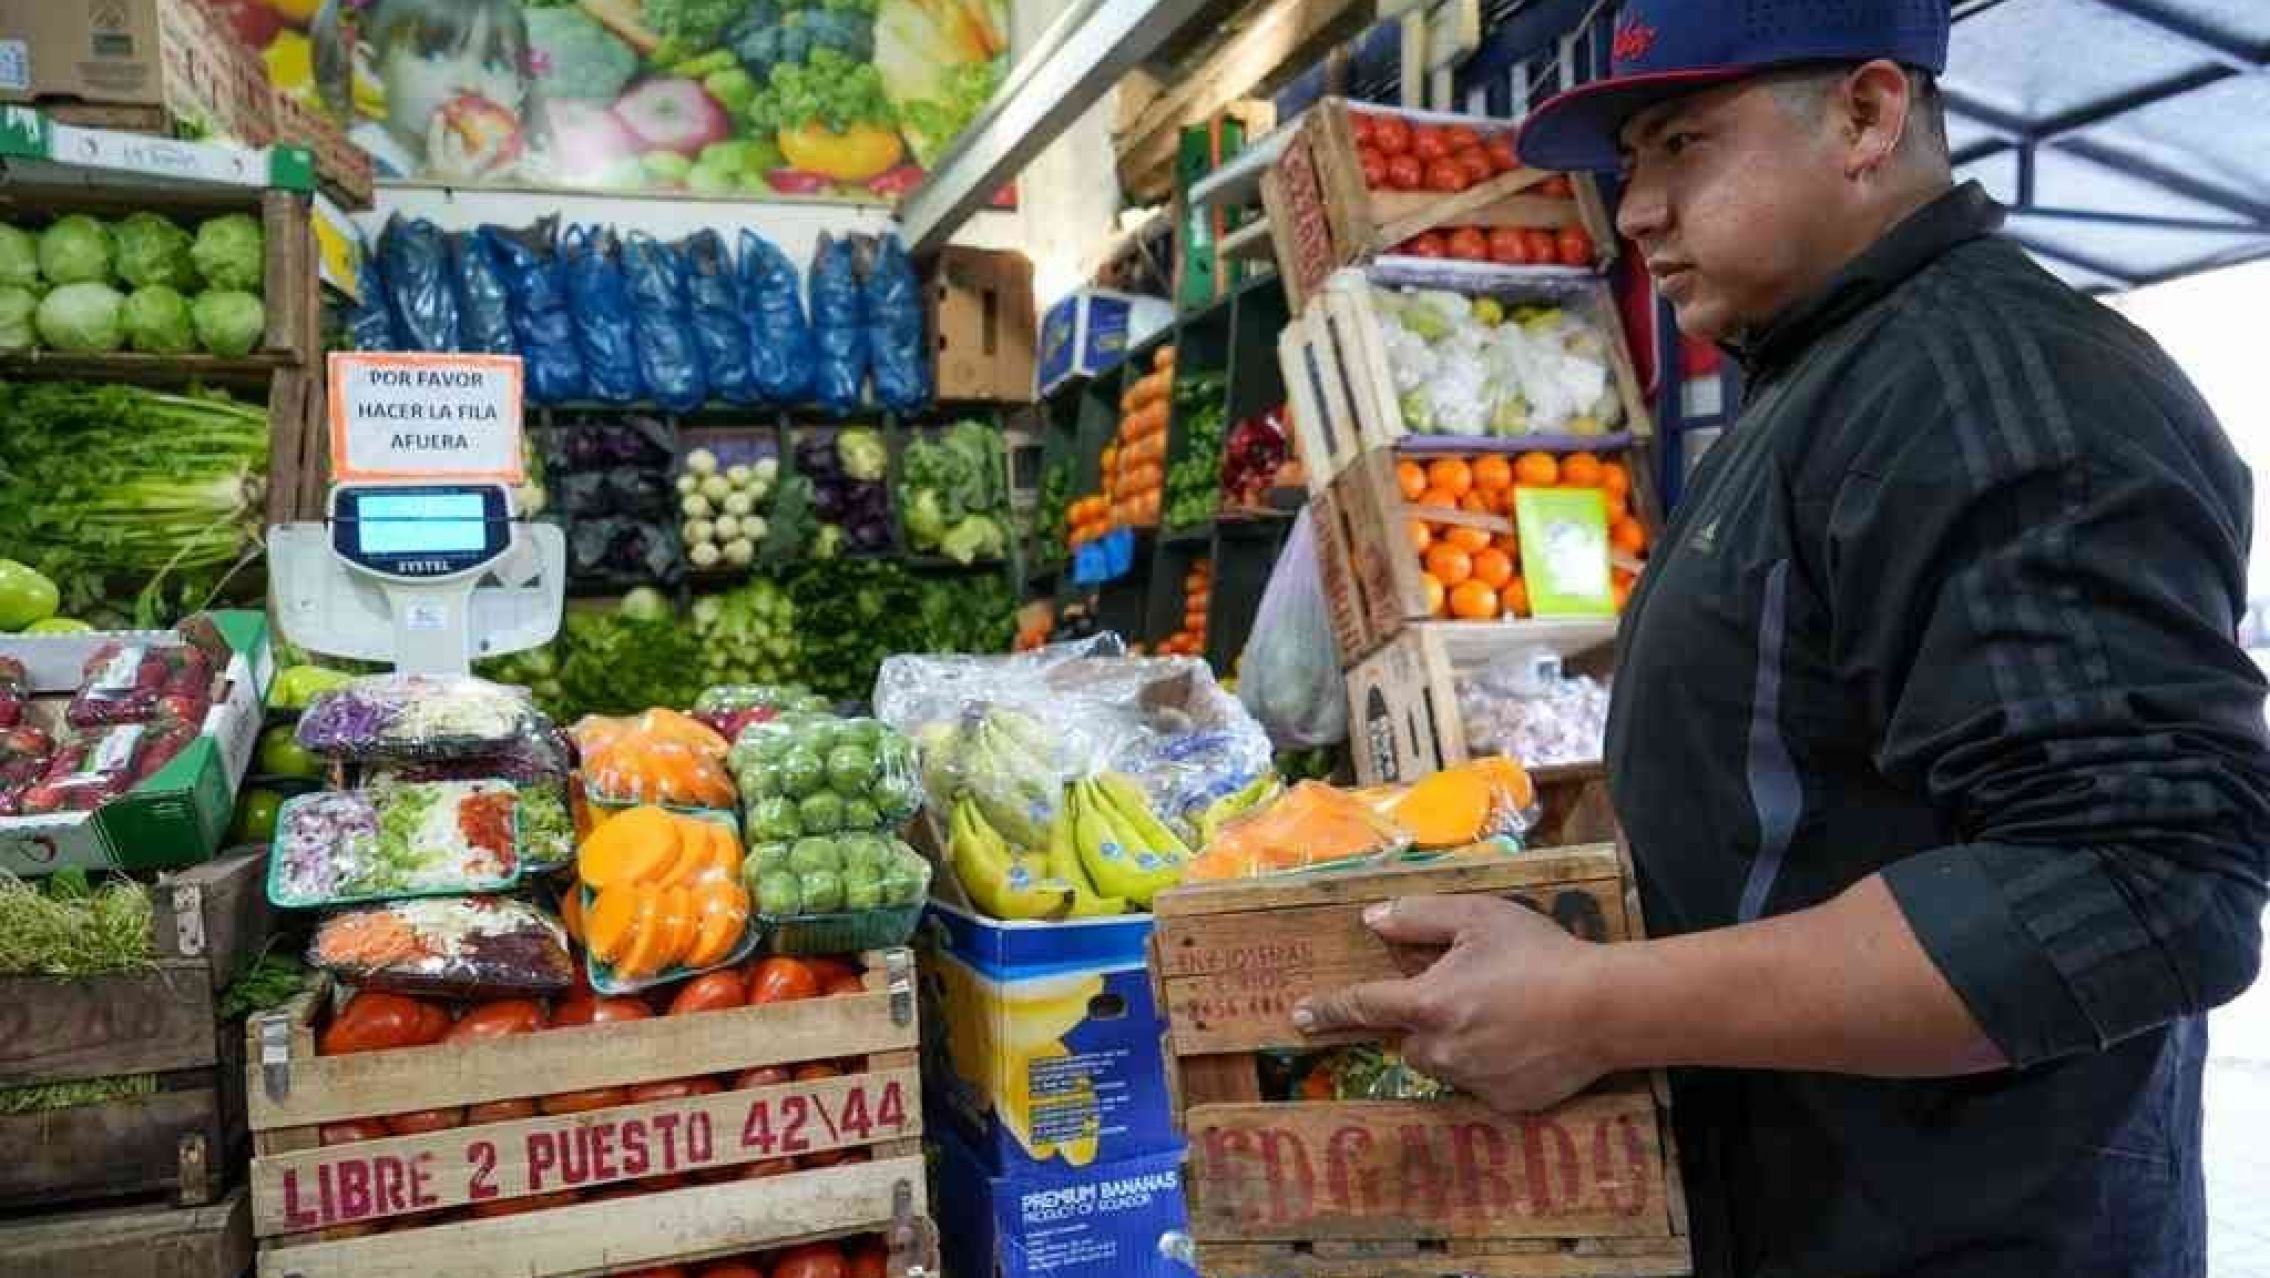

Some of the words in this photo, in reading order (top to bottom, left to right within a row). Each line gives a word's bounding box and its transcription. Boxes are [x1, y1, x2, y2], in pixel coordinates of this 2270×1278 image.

[370, 370, 411, 386] POR
[417, 370, 483, 387] FAVOR
[358, 402, 422, 418] HACER
[429, 403, 452, 419] LA
[457, 404, 498, 420] FILA
[391, 434, 469, 450] AFUERA
[283, 1150, 438, 1232] LIBRE
[466, 1141, 499, 1201] 2
[525, 1110, 713, 1192] PUESTO
[1021, 1183, 1097, 1212] PREMIUM
[1101, 1170, 1178, 1200] BANANAS
[1022, 1203, 1076, 1224] PRODUCT
[1099, 1193, 1154, 1212] ECUADOR
